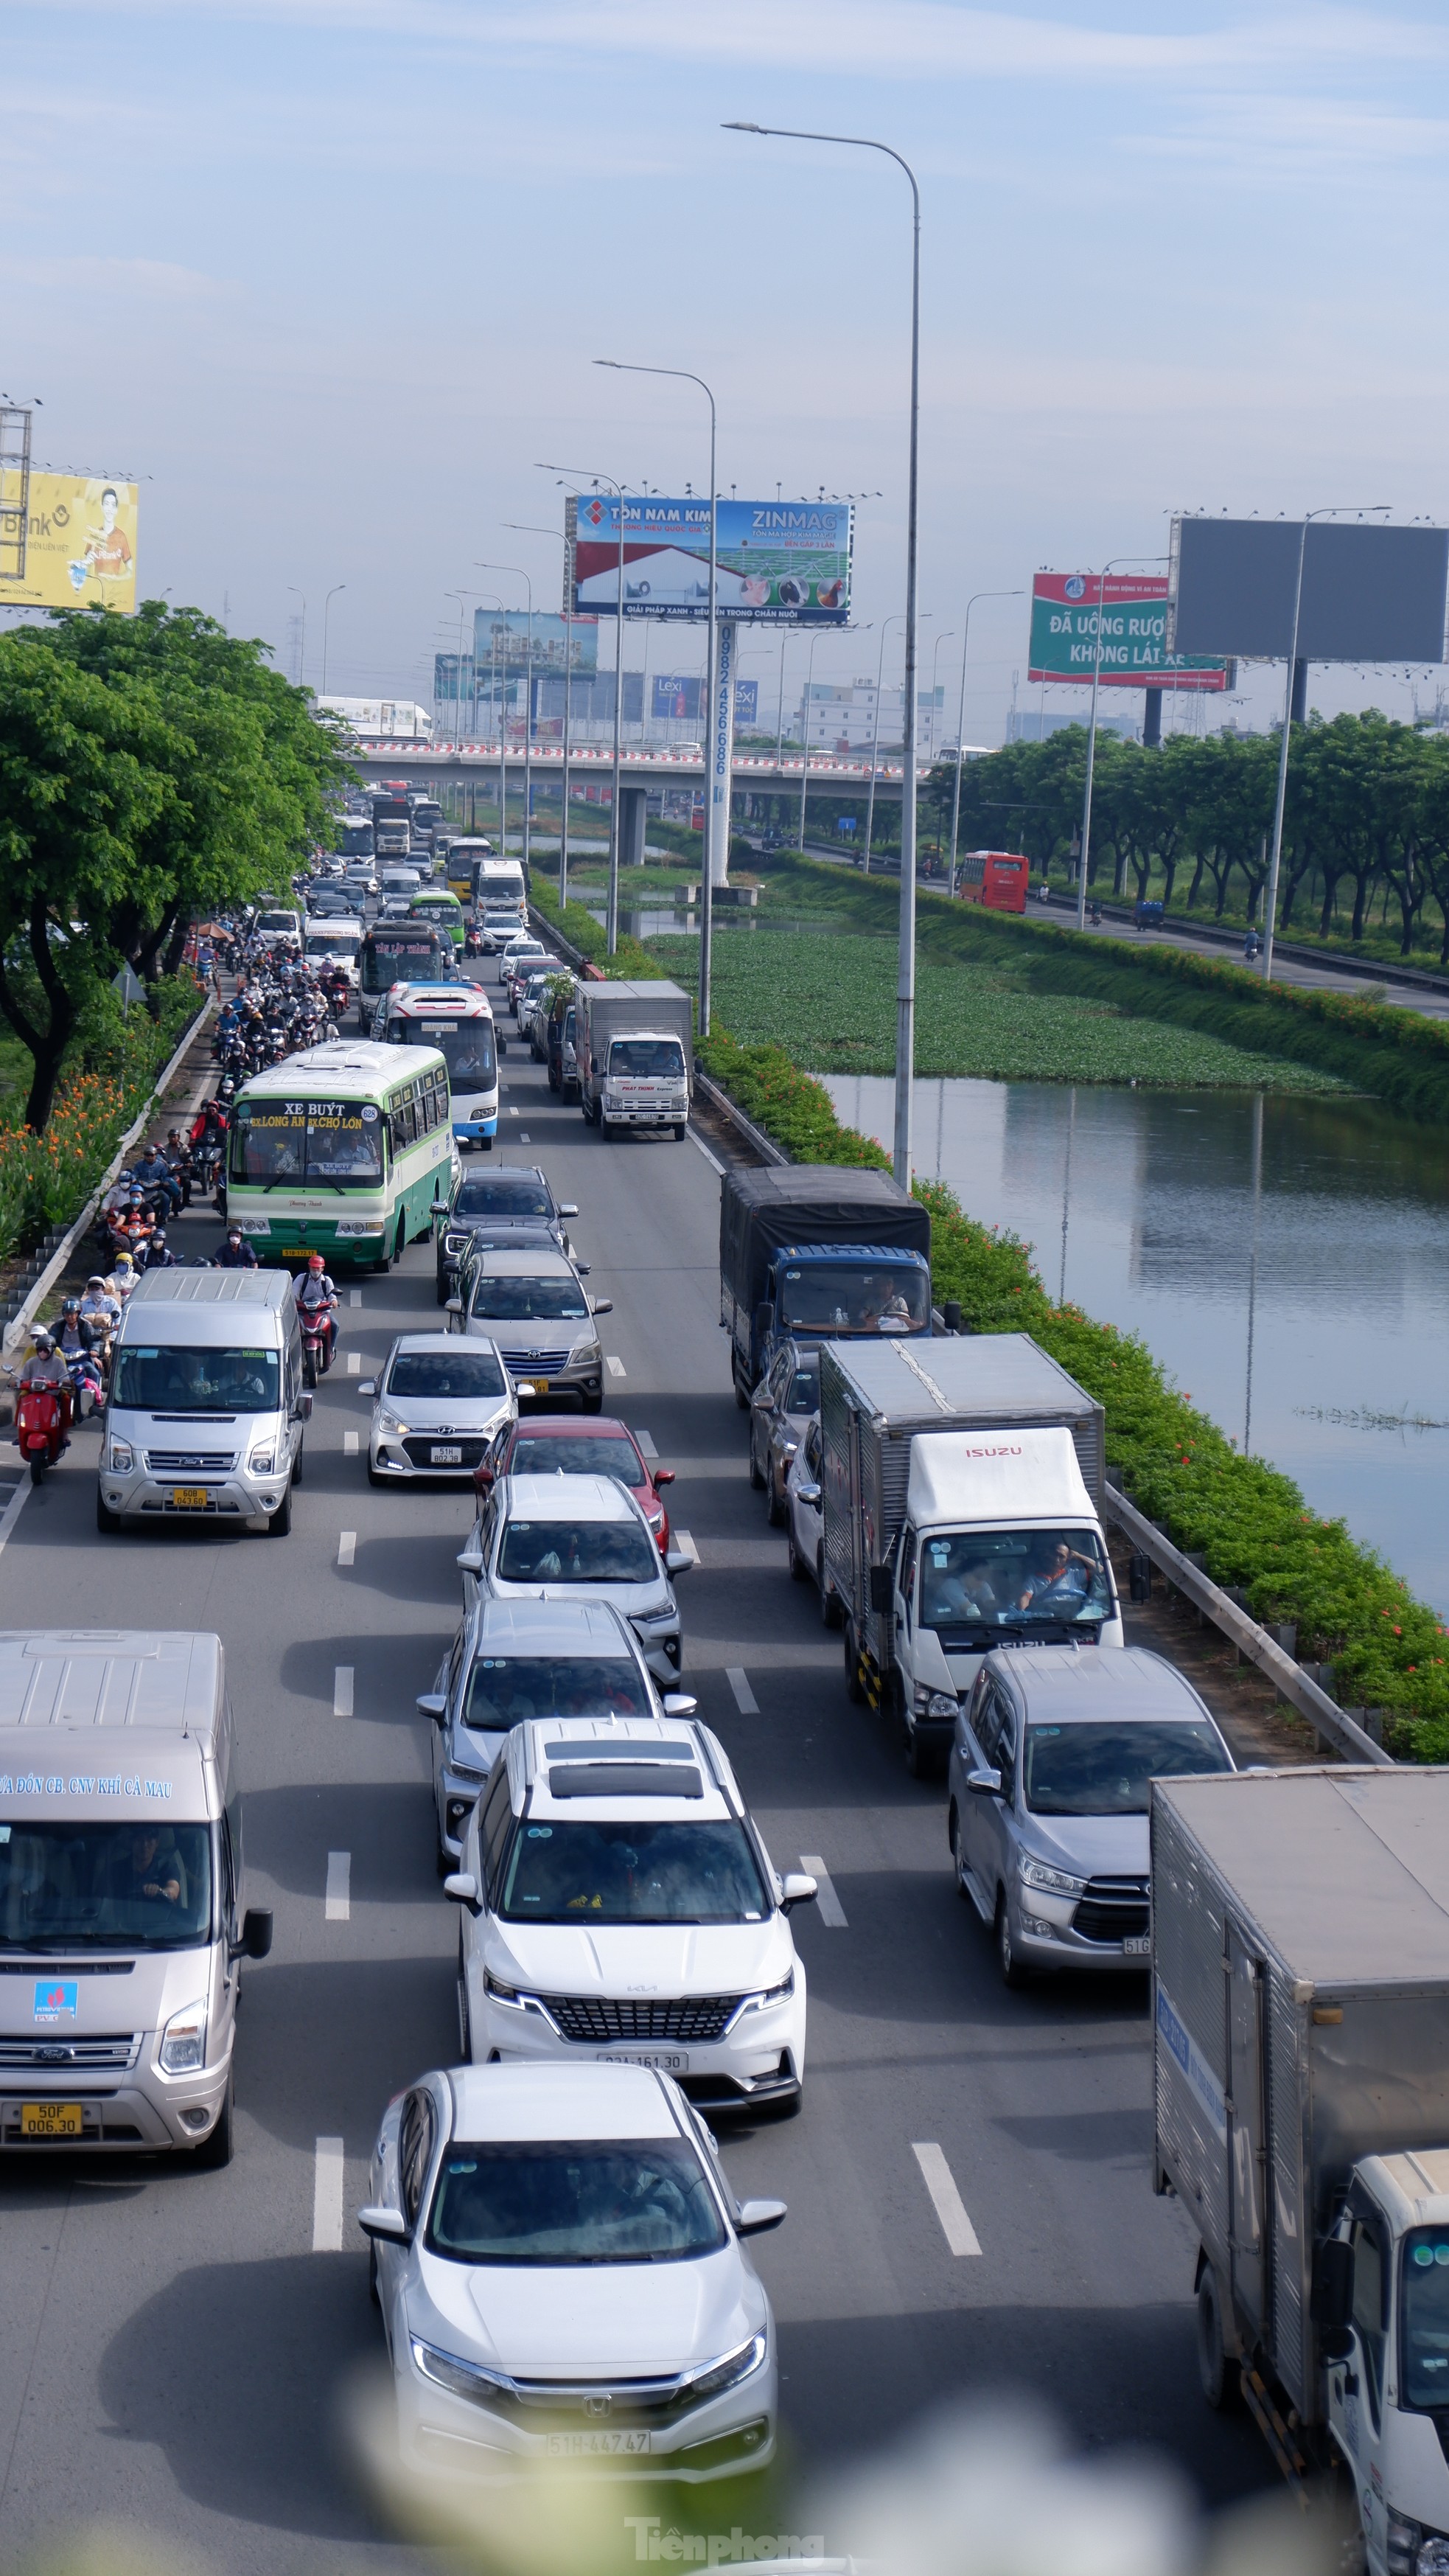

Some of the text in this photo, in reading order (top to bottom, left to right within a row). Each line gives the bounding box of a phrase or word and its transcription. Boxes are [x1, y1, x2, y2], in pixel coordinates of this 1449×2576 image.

[610, 505, 711, 522] TÔN NAM KIM
[752, 510, 837, 530] ZINMAG
[626, 605, 643, 613] GIẢI
[645, 605, 665, 614] PHÁP
[727, 609, 753, 617] TRONG
[778, 609, 798, 618] NUÔI
[1050, 611, 1072, 634] ĐÃ
[1128, 616, 1167, 641] RƯỢ
[720, 627, 731, 684] 0982
[1069, 639, 1128, 663] KHÔNG
[1134, 641, 1161, 664] LÁI
[718, 687, 728, 729] 456
[716, 732, 727, 775] 686
[375, 941, 389, 953] TÂN
[284, 1101, 345, 1116] XE BUÝT
[363, 1109, 376, 1118] 628
[291, 1116, 305, 1127] AN
[341, 1115, 363, 1129] LỚN
[966, 1447, 1022, 1458] ISUZU
[183, 1489, 198, 1497] 60B
[997, 1640, 1045, 1650] ISUZU
[15, 1773, 43, 1795] ĐÓN
[46, 1778, 66, 1795] CB.
[69, 1778, 95, 1795] CNV
[97, 1775, 122, 1795] KHÍ
[124, 1775, 142, 1797] CÀ
[144, 1780, 172, 1799] MAU
[41, 2049, 64, 2059] Ford
[39, 2106, 65, 2118] 50F
[28, 2120, 75, 2133] 006.30
[551, 2434, 646, 2454] 51H-447.47
